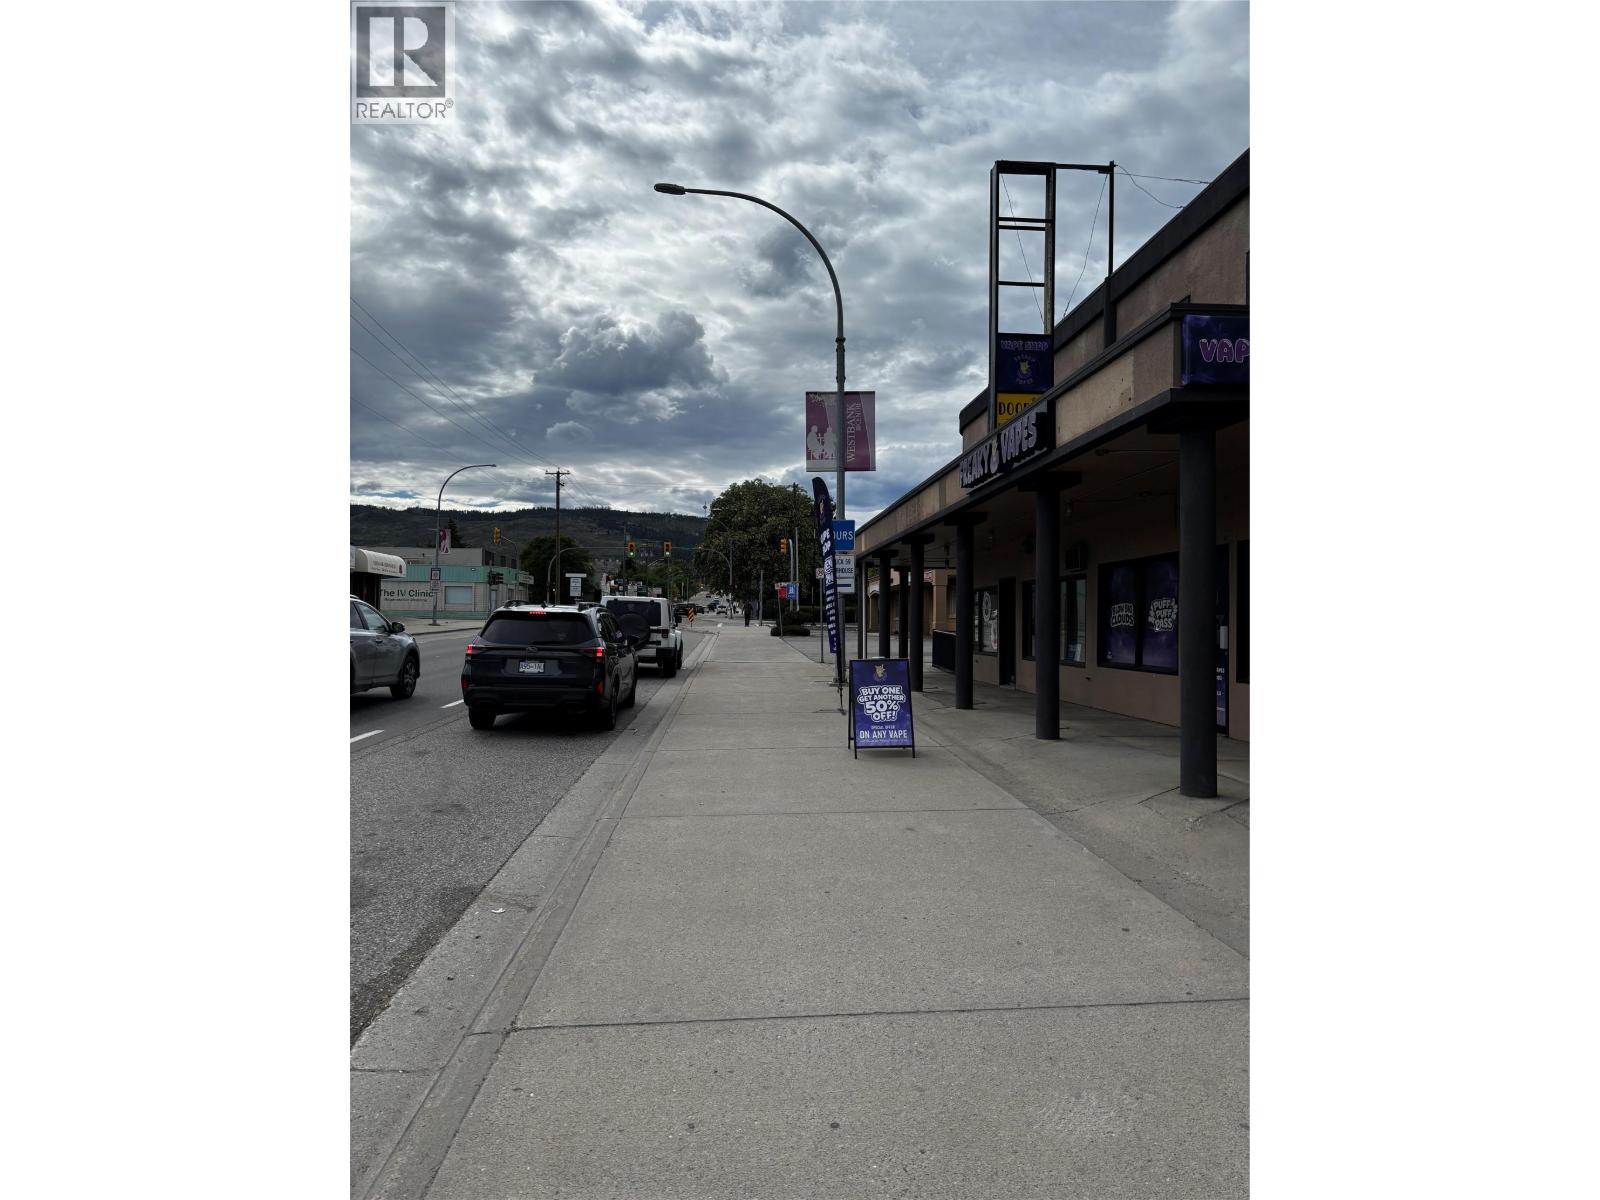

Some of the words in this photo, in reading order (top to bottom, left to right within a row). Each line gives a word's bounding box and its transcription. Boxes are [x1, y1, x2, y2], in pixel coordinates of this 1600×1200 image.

[846, 401, 856, 464] WESTBANK
[1000, 410, 1038, 464] VAPES
[408, 589, 434, 598] Clinic
[1153, 599, 1171, 609] PUFF
[1155, 609, 1173, 619] PUFF
[1111, 613, 1135, 626] CLOUDS
[1154, 617, 1174, 631] PASS
[861, 687, 880, 696] BUY
[882, 686, 900, 694] ONE
[859, 695, 872, 703] GET
[866, 700, 898, 713] 50%
[873, 711, 895, 720] OFF!
[859, 730, 869, 738] ON
[872, 730, 886, 738] ANY
[889, 729, 907, 738] VAPE
